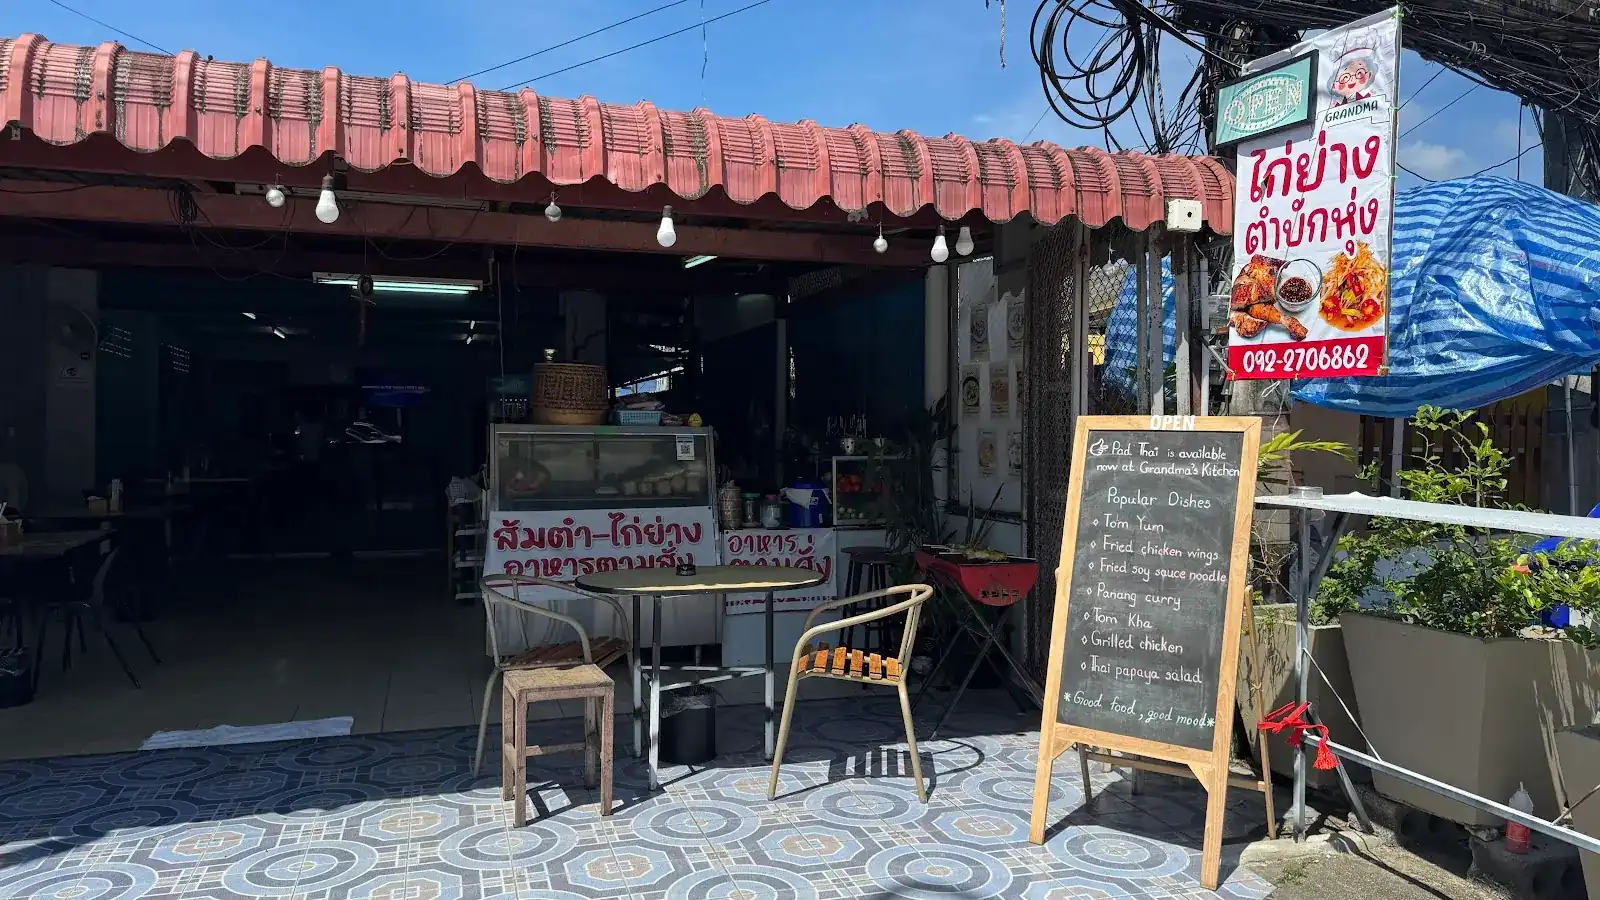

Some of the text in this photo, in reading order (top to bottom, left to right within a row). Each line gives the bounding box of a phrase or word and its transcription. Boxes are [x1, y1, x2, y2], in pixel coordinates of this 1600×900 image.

[1224, 80, 1304, 126] OPEN
[1326, 101, 1378, 122] GRANDMA
[1250, 130, 1380, 202] ไก่ย่าง
[1246, 186, 1378, 256] ตำบักหุ่ง
[1243, 344, 1368, 372] 092-2706862
[1150, 414, 1195, 430] OPEN
[1112, 440, 1226, 460] Pad Thai is available
[1096, 461, 1240, 477] now at Grandma's Kitchen
[1108, 486, 1211, 509] Popular Dishes
[1104, 514, 1164, 532] Tom Yum
[728, 534, 796, 552] อาหาร
[1104, 534, 1218, 566] Fried chicken wings
[1100, 558, 1227, 582] Fried soy sauce noodle
[1097, 582, 1180, 611] Panang curry
[1094, 607, 1152, 628] Tom Kha
[1092, 630, 1184, 654] Grilled chicken
[1090, 654, 1202, 684] Thai papaya salad
